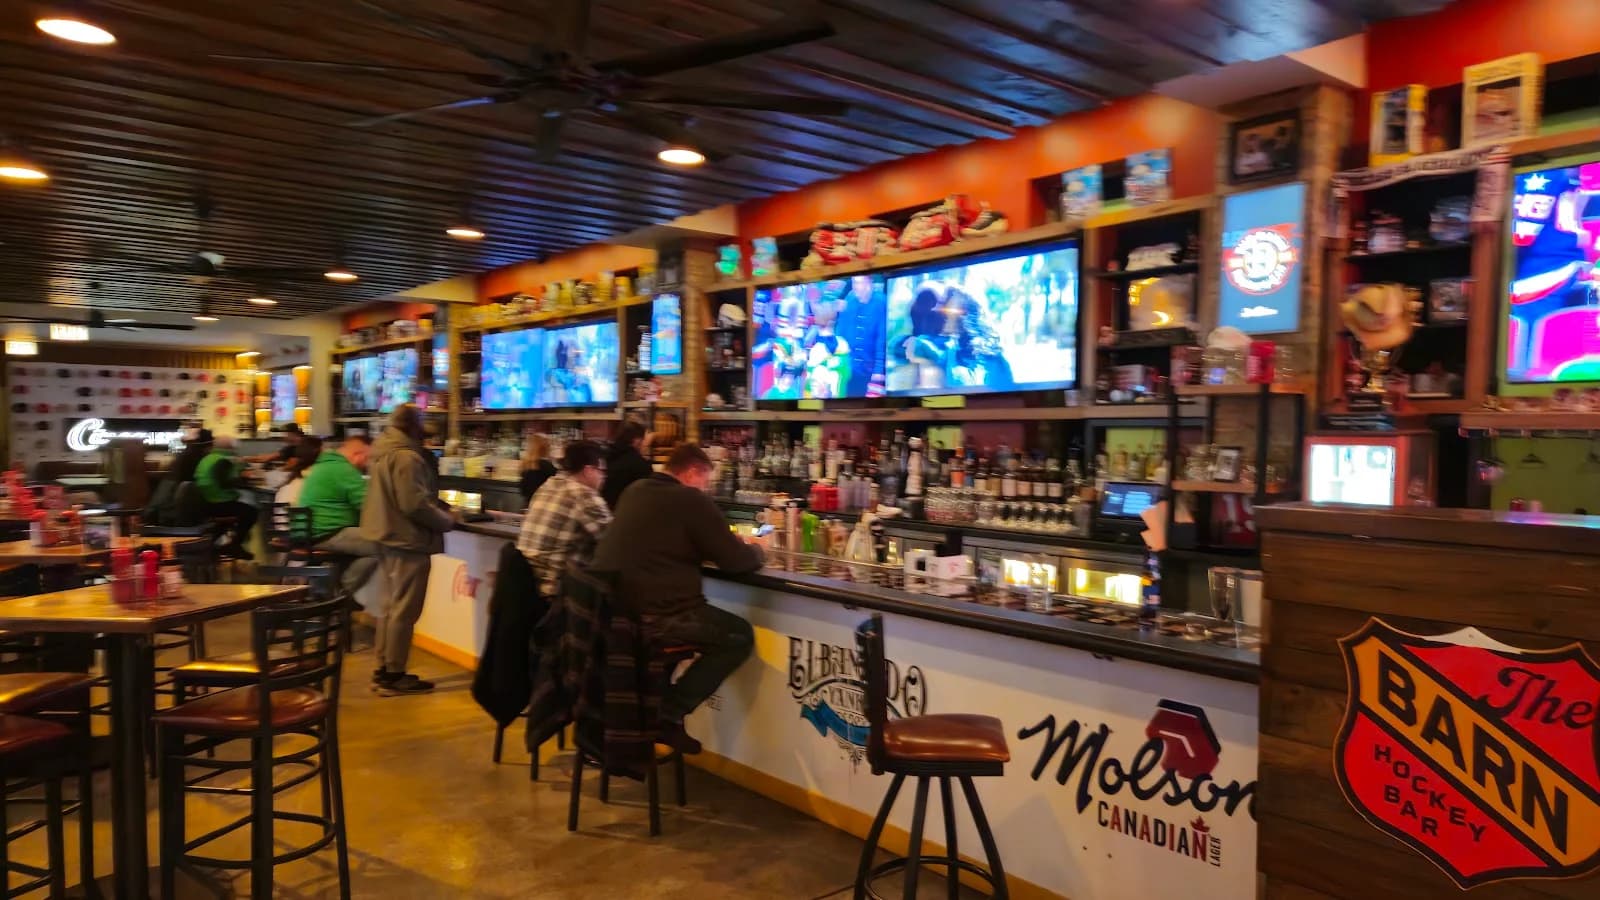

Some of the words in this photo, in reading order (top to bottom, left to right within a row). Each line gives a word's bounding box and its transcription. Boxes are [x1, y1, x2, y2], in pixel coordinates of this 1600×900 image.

[1477, 667, 1594, 730] The
[1017, 714, 1259, 823] Molson
[1378, 650, 1569, 855] BARN
[1374, 743, 1488, 843] HOCKEY
[1383, 784, 1439, 838] BAR
[1097, 800, 1208, 862] CANADIAN
[1209, 836, 1222, 867] LAGER
